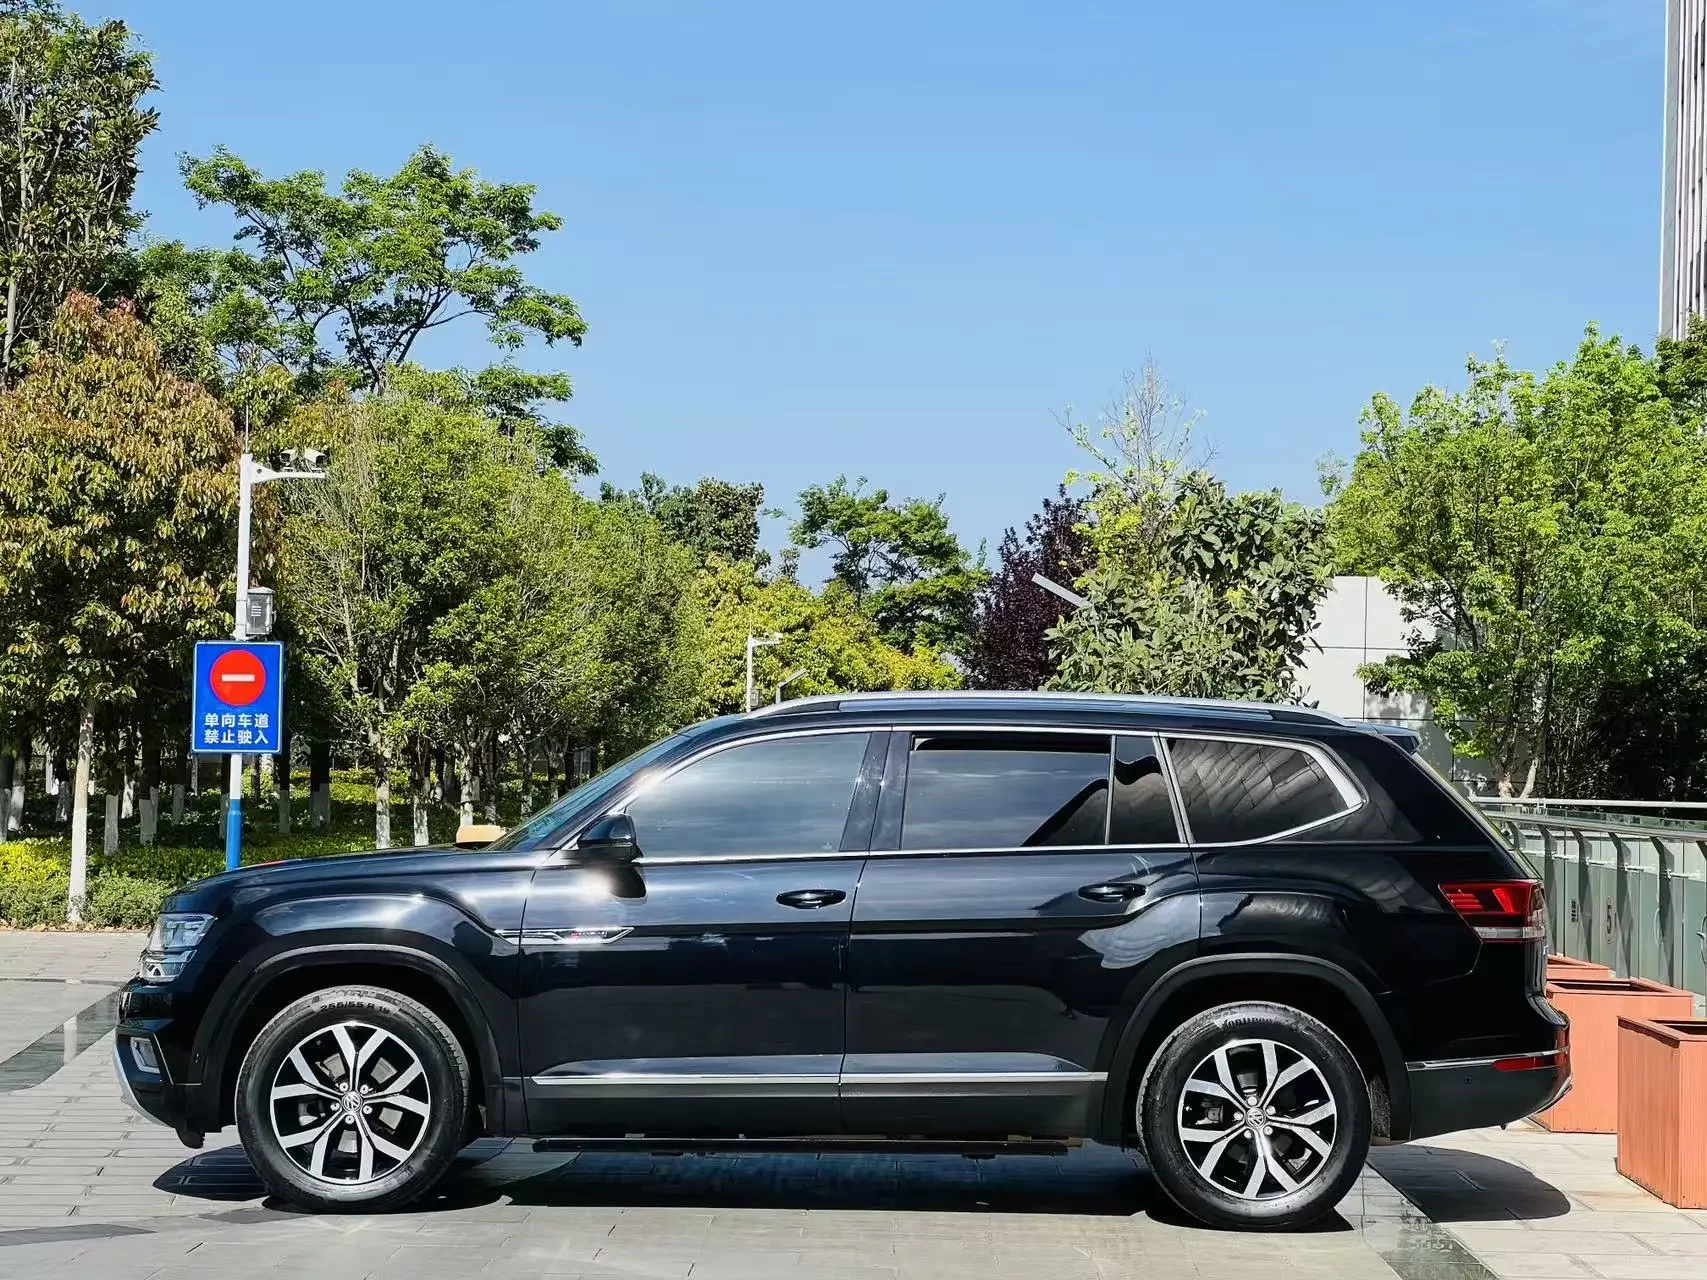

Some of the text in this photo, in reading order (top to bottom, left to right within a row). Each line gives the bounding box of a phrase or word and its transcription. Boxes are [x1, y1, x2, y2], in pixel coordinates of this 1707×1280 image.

[204, 713, 269, 728] 单向车道
[204, 729, 269, 744] 禁止驶入
